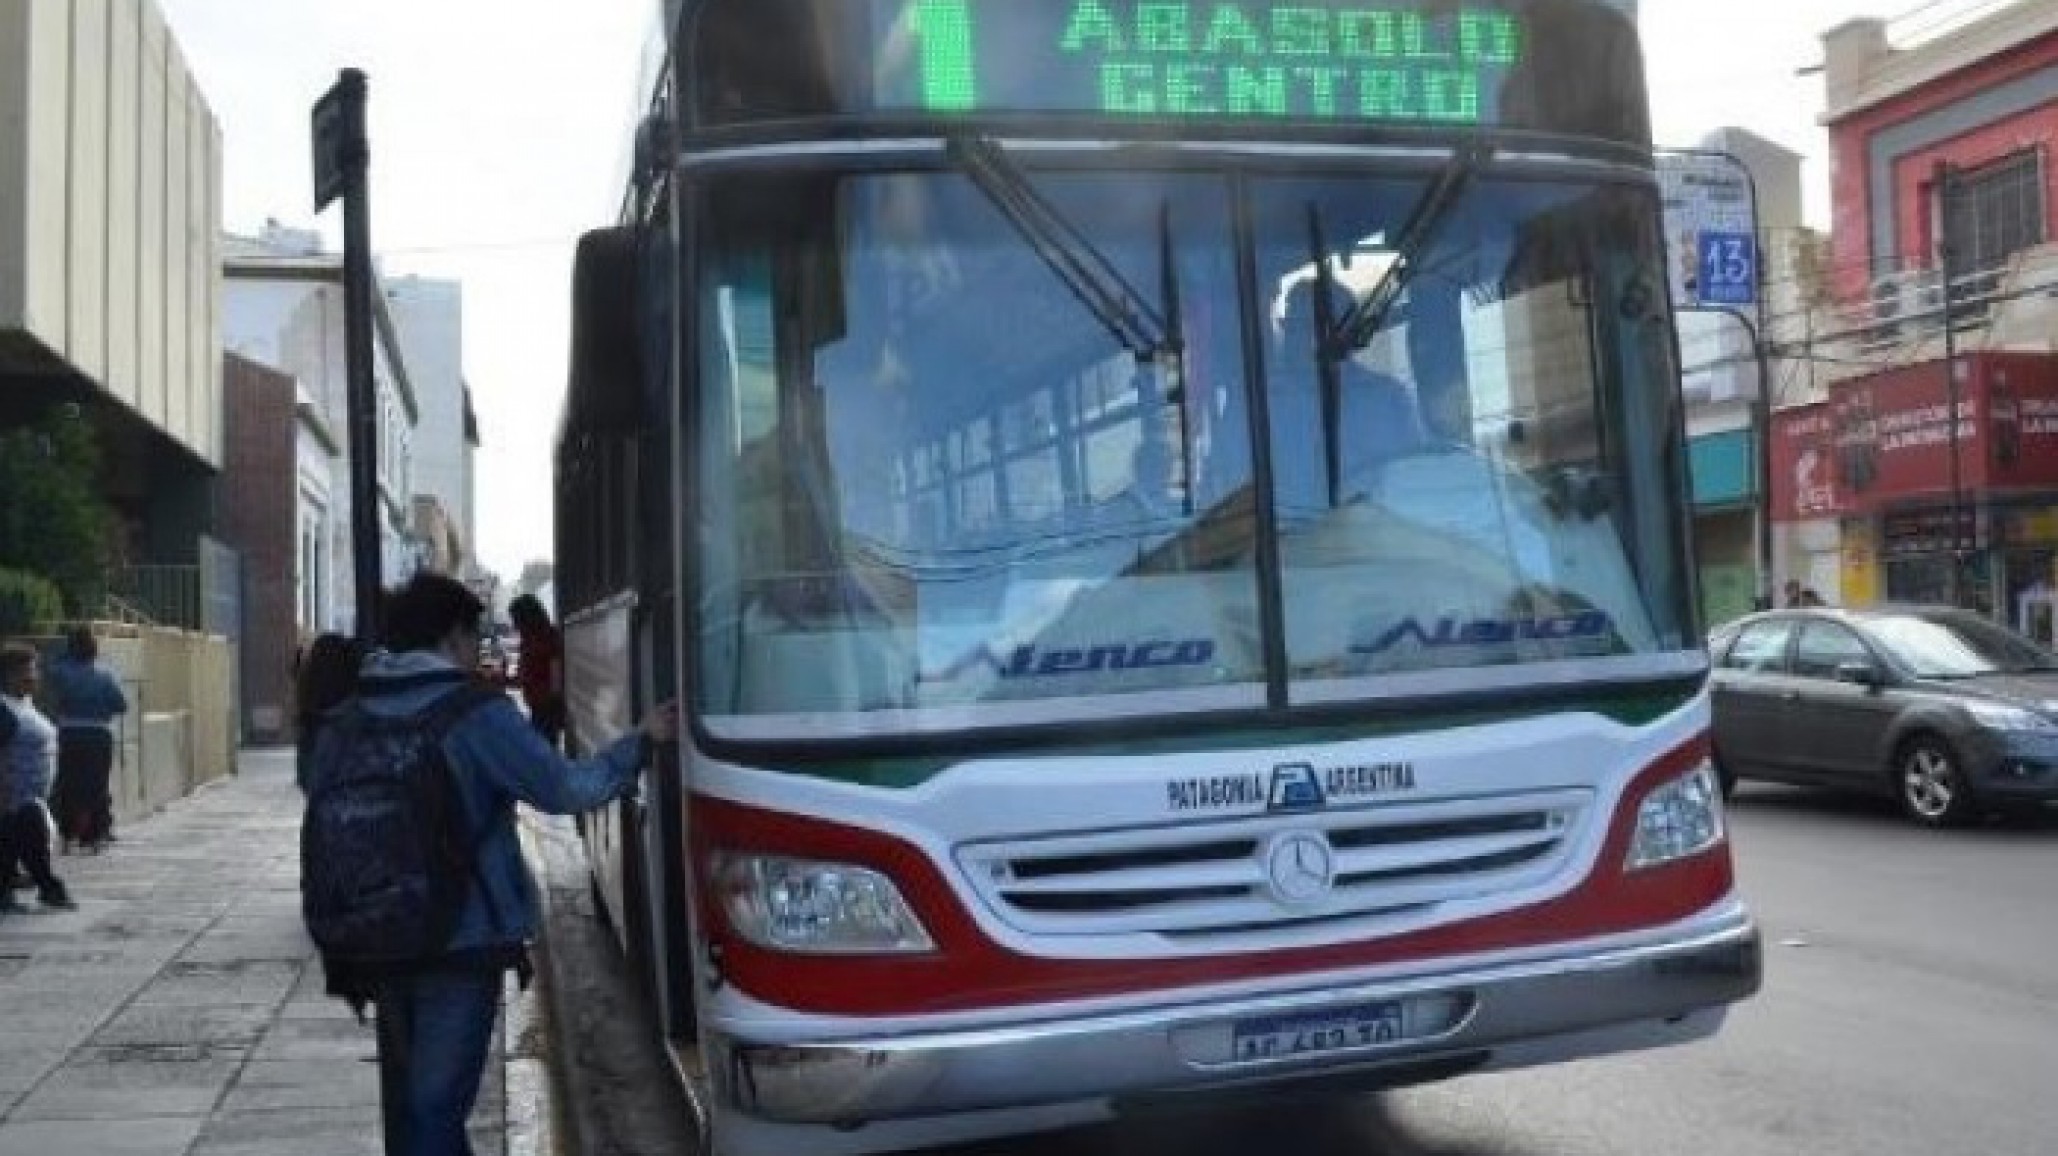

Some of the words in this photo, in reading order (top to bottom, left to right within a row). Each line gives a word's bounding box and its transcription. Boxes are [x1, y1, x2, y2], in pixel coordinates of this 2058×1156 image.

[907, 0, 974, 112] 1
[1060, 0, 1517, 63] ABASOLO
[1102, 64, 1478, 119] CENTRO
[1707, 239, 1749, 283] 13
[1166, 771, 1265, 810] PATAGONIA
[1325, 761, 1417, 796] ARGENTINA
